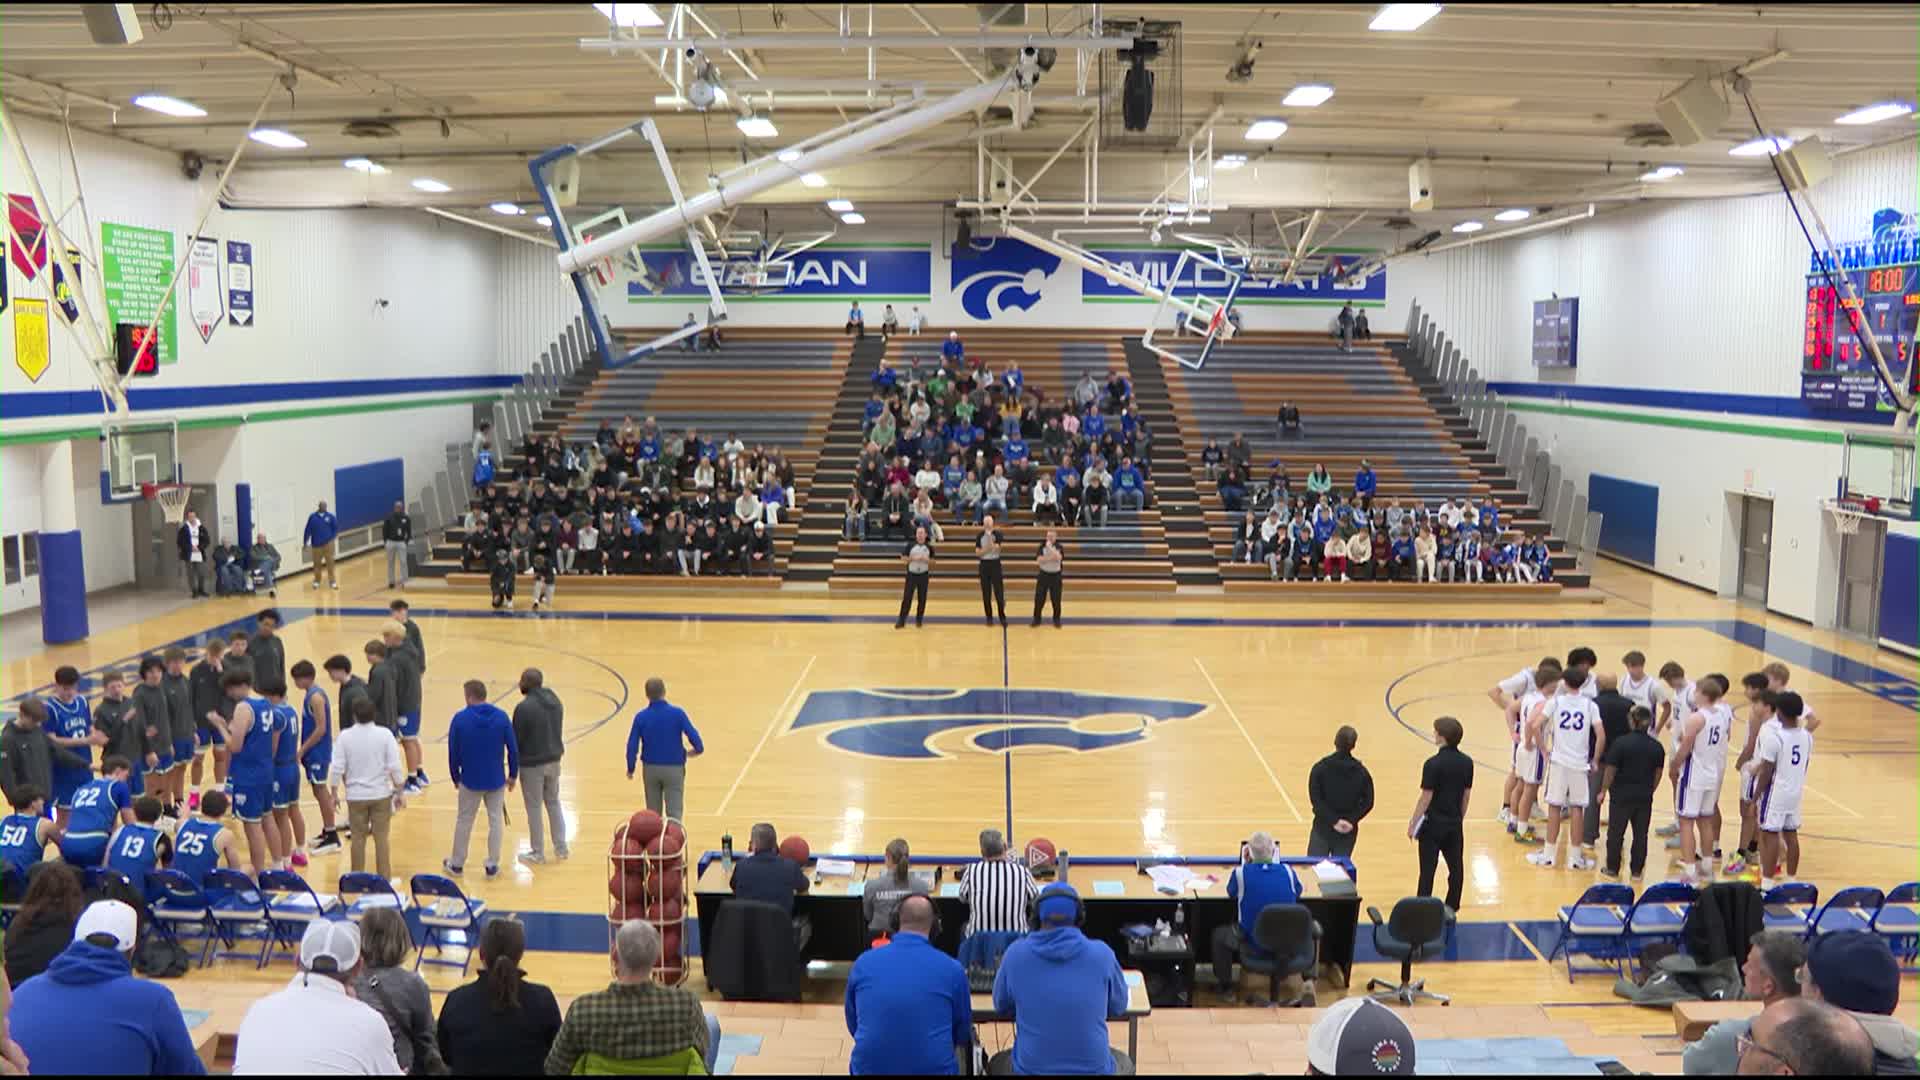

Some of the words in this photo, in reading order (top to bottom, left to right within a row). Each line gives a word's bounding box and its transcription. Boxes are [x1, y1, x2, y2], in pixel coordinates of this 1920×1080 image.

[1559, 710, 1585, 731] 23
[1708, 725, 1720, 746] 15
[1791, 744, 1801, 766] 5
[75, 787, 101, 807] 22
[0, 824, 28, 847] 50
[121, 835, 145, 858] 13
[177, 831, 209, 856] 25
